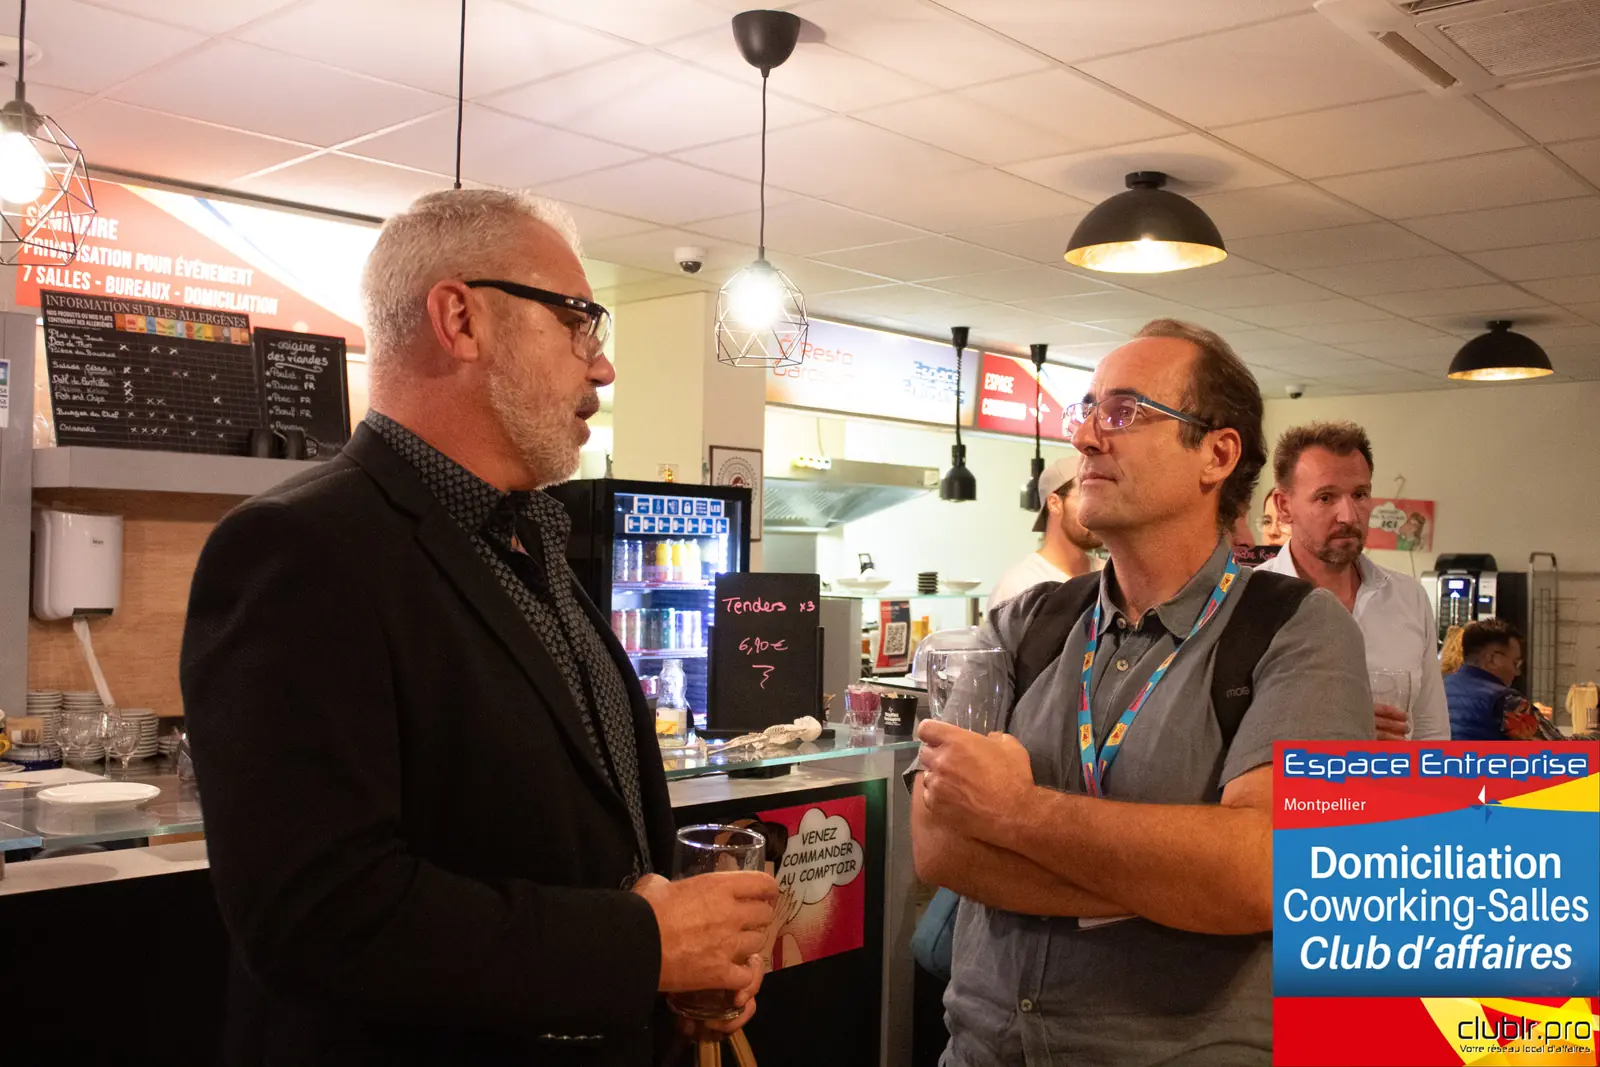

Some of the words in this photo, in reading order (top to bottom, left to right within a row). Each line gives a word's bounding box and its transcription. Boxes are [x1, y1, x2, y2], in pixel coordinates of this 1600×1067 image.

[23, 237, 133, 270] PRIVATISATION
[135, 252, 172, 275] POUR
[22, 265, 32, 282] 7
[36, 265, 91, 291] SALLES
[105, 275, 171, 301] BUREAUX
[183, 286, 279, 316] DOMICILIATION
[45, 294, 131, 314] INFORMATION
[131, 303, 155, 317] SUR
[157, 307, 177, 319] LES
[178, 309, 247, 328] ALLERGÈNES
[277, 341, 317, 355] origine
[799, 341, 853, 365] Resto
[267, 351, 285, 362] des
[287, 354, 328, 367] viandes
[303, 381, 316, 391] FR
[984, 372, 1015, 394] ESPACE
[300, 396, 312, 405] FR
[1381, 520, 1398, 529] ICI
[722, 597, 787, 615] Tenders
[799, 600, 816, 612] x3
[801, 827, 838, 845] VENEZ
[782, 842, 853, 868] COMMANDER
[779, 872, 796, 886] AU
[799, 859, 857, 883] COMPTOIR
